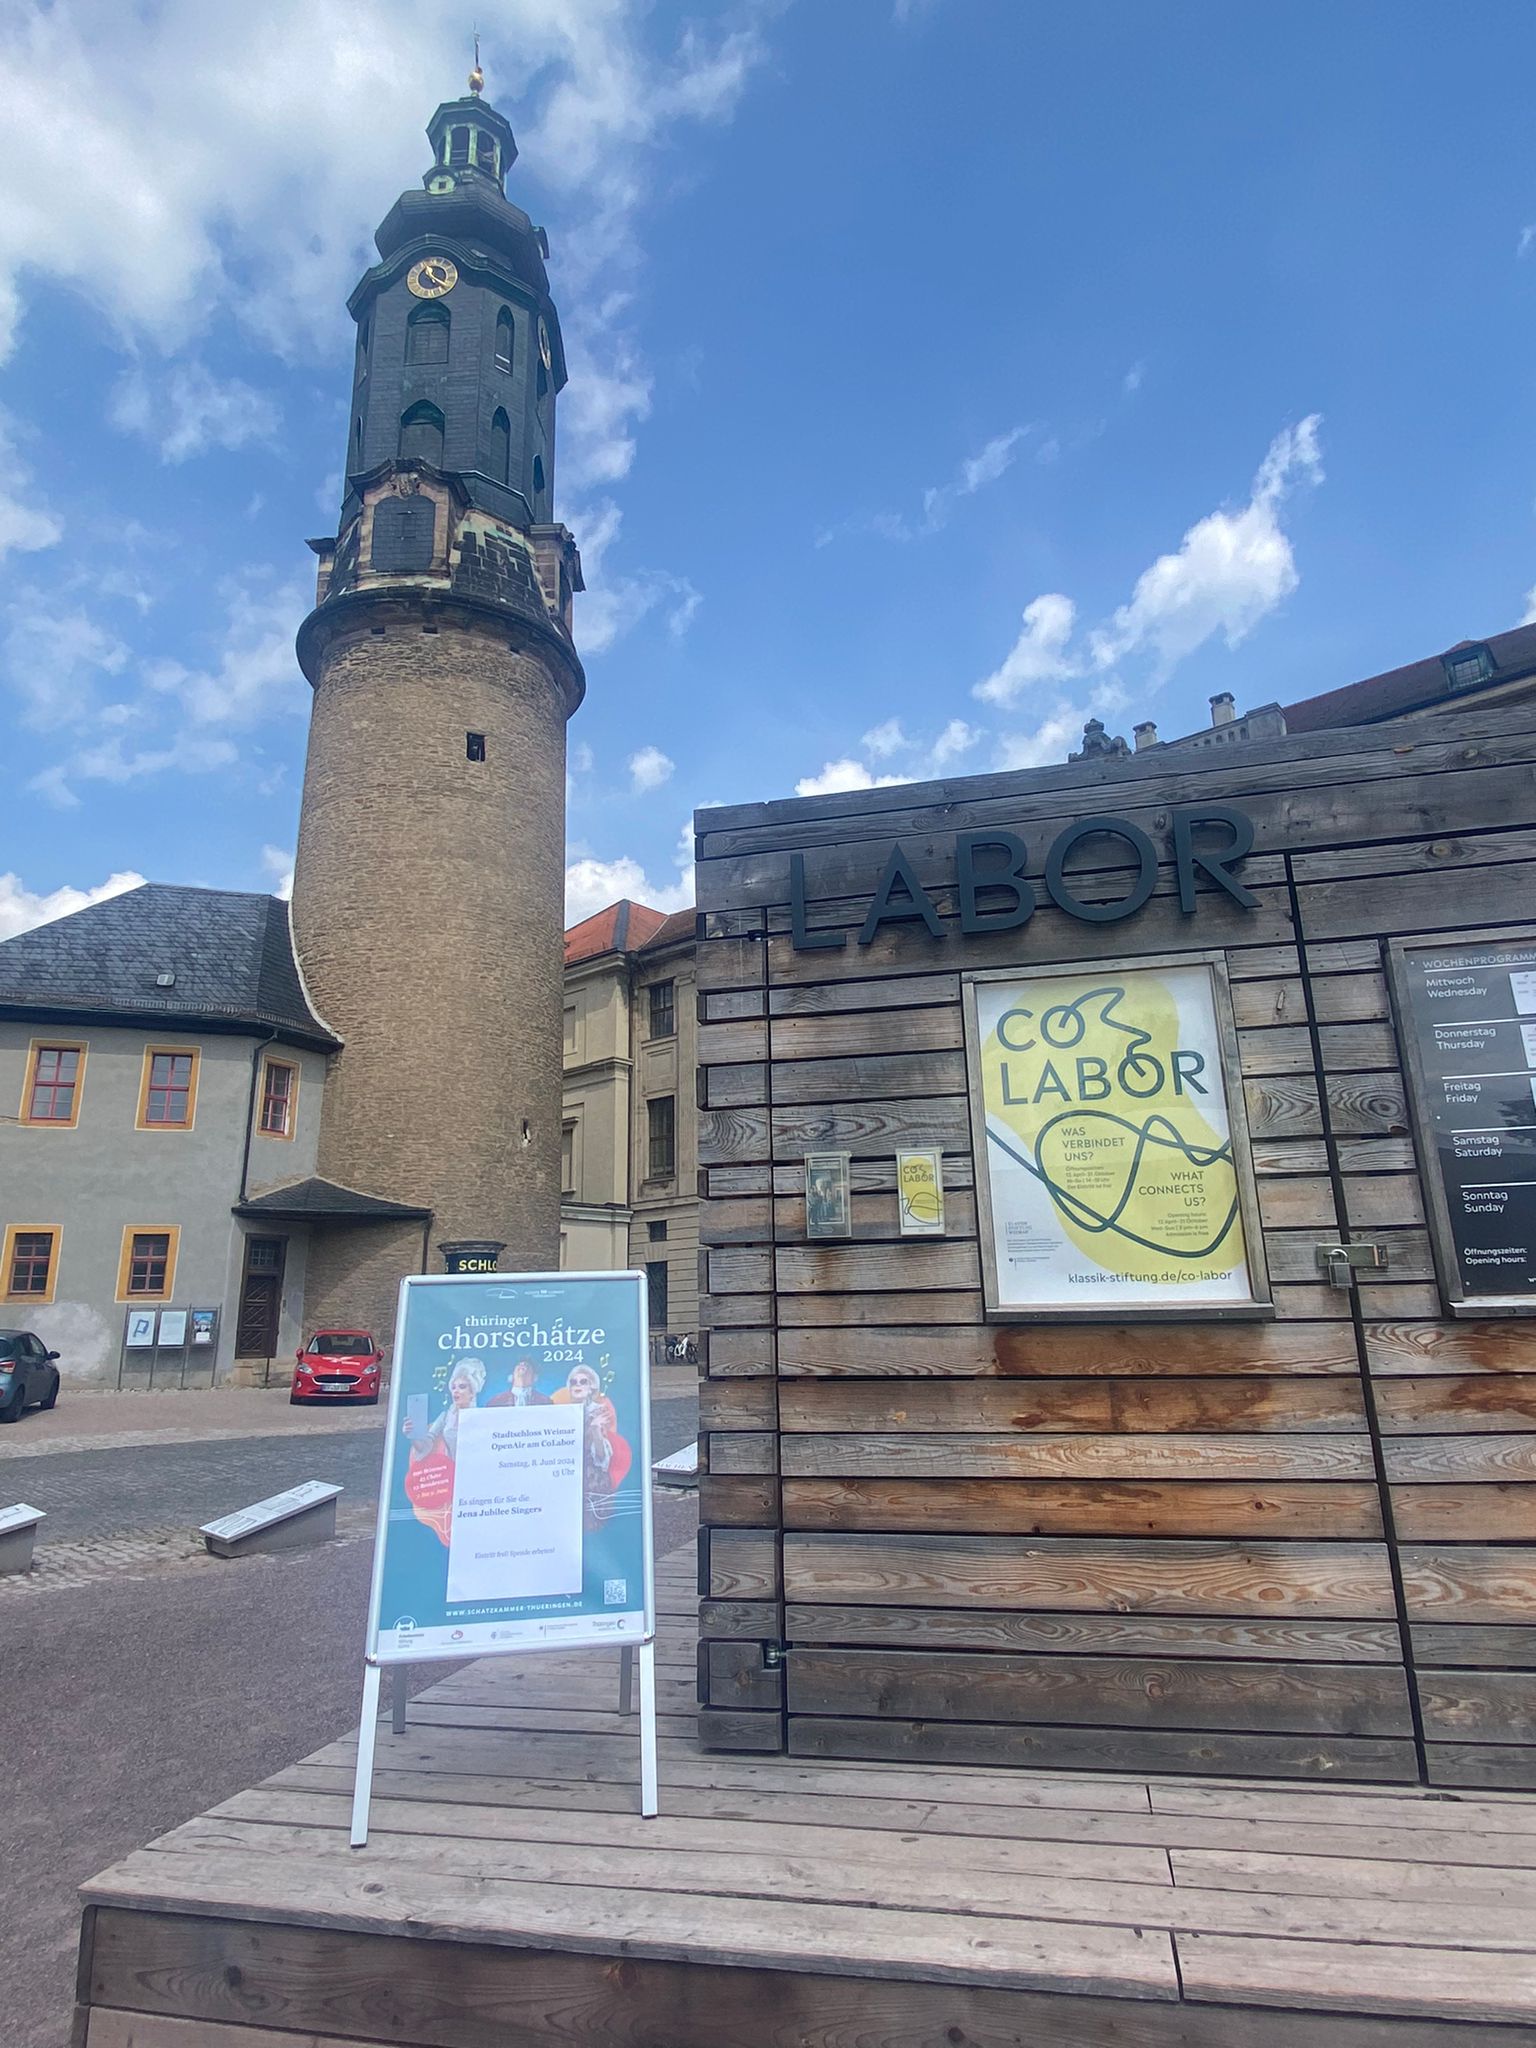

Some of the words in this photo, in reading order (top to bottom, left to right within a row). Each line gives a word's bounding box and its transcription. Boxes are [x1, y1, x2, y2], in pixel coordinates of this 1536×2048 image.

[790, 806, 1263, 951] LABOR
[1426, 976, 1475, 988] Mittwoch
[1427, 987, 1488, 998] Wednesday
[996, 1004, 1086, 1052] CO
[1435, 1028, 1497, 1039] Donnerstag
[1436, 1040, 1485, 1050] Thursday
[1000, 1049, 1209, 1106] LABOR
[1443, 1082, 1482, 1092] Freitag
[1446, 1094, 1479, 1103] Friday
[1061, 1127, 1086, 1137] WAS
[1062, 1137, 1126, 1149] VERBINDET
[1453, 1136, 1500, 1146] Samstag
[1064, 1152, 1094, 1162] UNS?
[1455, 1147, 1503, 1158] Saturday
[903, 1173, 935, 1183] LABOR
[1170, 1171, 1204, 1181] WHAT
[1138, 1183, 1204, 1195] CONNECTS
[1462, 1191, 1508, 1201] Sonntag
[1184, 1197, 1207, 1207] US?
[1464, 1203, 1504, 1213] Sunday
[1464, 1247, 1528, 1256] Öffnungszeiten:
[1465, 1257, 1500, 1265] Opening
[1068, 1269, 1233, 1284] klassik-stiftung.de/co-labor
[465, 1314, 529, 1328] thüringer
[438, 1319, 606, 1350] chorschätze
[543, 1349, 584, 1362] 2024
[492, 1429, 541, 1439] Stadtschloss
[543, 1428, 576, 1436] Weimar
[491, 1441, 526, 1451] OpenAir
[541, 1439, 576, 1447] CoLabor
[540, 1458, 556, 1466] Juni
[458, 1498, 467, 1506] Es
[469, 1497, 492, 1506] singen
[494, 1495, 504, 1504] für
[506, 1495, 517, 1503] Sie
[518, 1494, 530, 1502] die
[457, 1510, 477, 1518] Jena
[479, 1507, 509, 1517] Jubilee
[511, 1505, 542, 1515] Singers
